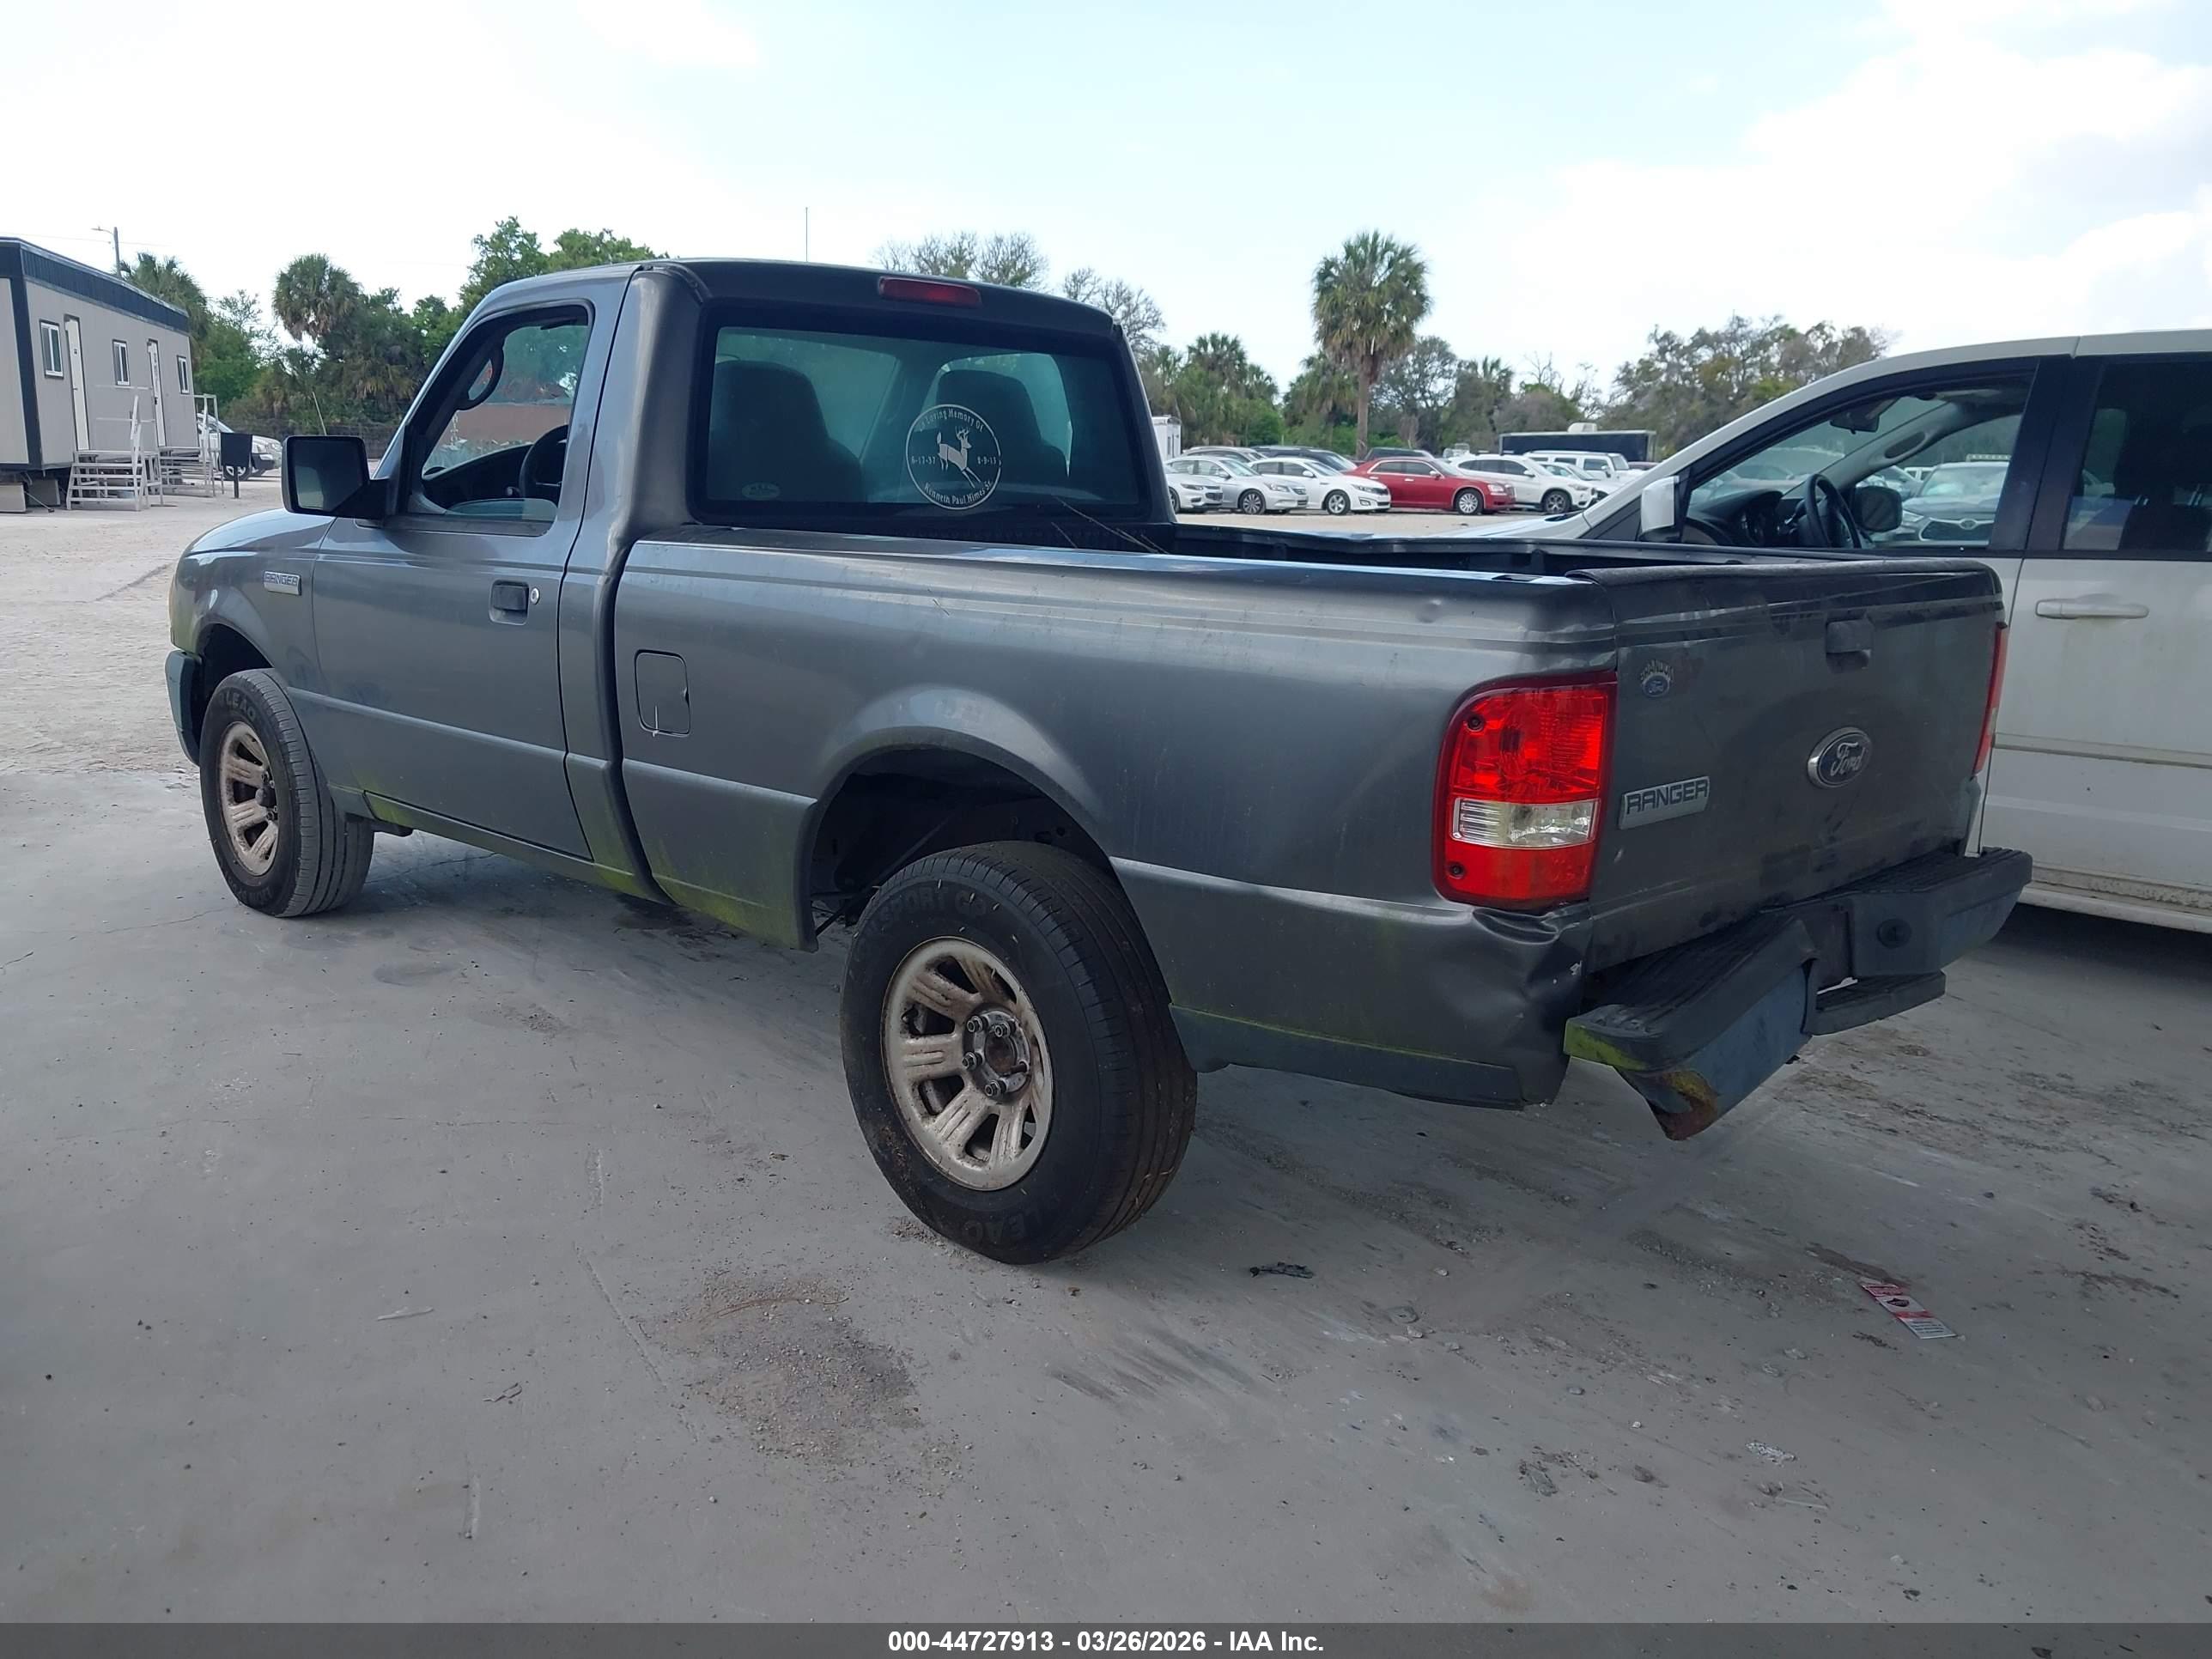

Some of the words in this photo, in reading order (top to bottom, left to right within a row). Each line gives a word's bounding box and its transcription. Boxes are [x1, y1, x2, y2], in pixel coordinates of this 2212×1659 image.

[948, 408, 974, 427] Memory
[924, 482, 951, 504] Kenneth
[951, 494, 967, 505] Paul
[966, 488, 986, 503] Himes
[1830, 742, 1866, 776] Ford
[1626, 779, 1709, 815] RANGER
